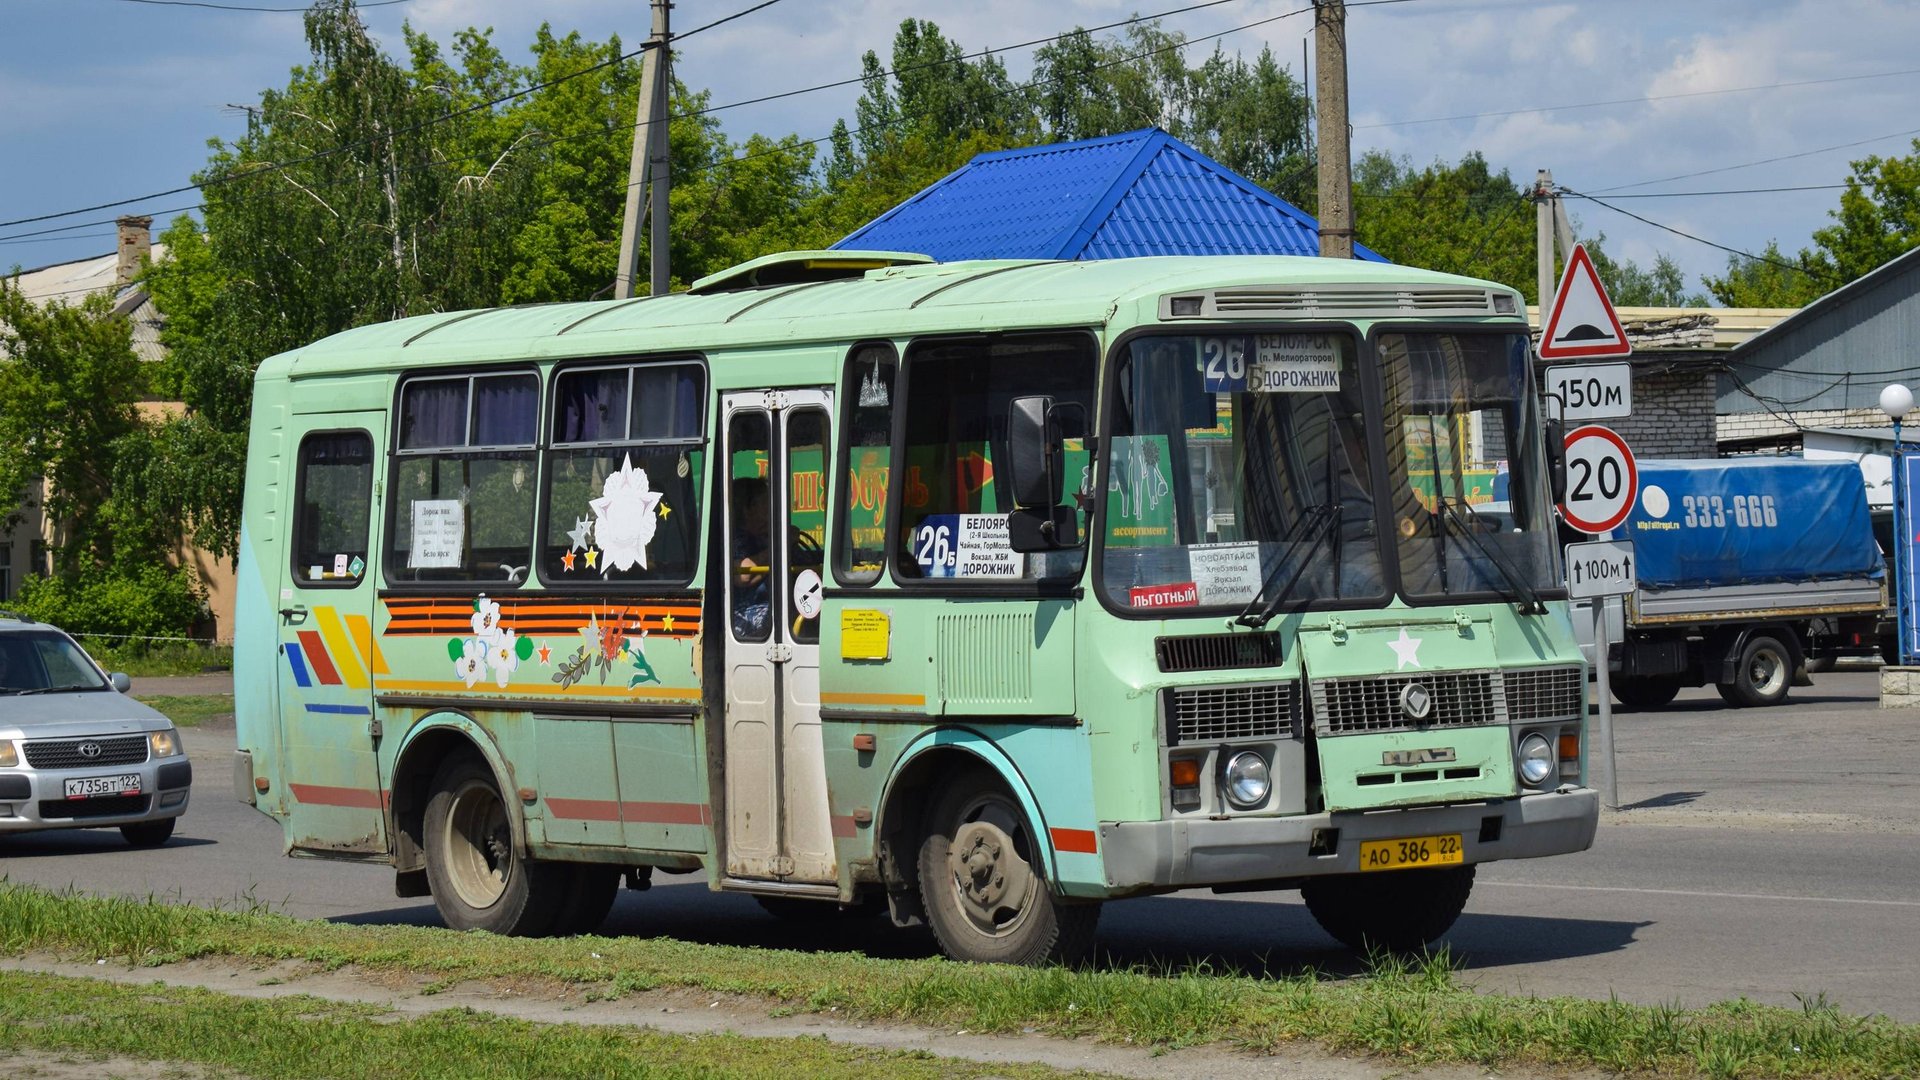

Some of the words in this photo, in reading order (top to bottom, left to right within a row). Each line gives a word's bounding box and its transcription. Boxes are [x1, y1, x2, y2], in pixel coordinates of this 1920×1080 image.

[1205, 338, 1245, 379] 26
[1273, 352, 1336, 363] Мелиораторов)
[1264, 371, 1338, 388] ДОРОЖНИК
[1569, 456, 1622, 502] 20
[1682, 495, 1778, 528] 333-666
[994, 553, 1009, 561] ЖБИ
[962, 563, 1015, 576] ДОРОЖНИК
[1132, 587, 1197, 608] ЛЬГОТНЫЙ
[1205, 585, 1252, 596] ДОРОЖНИК
[120, 776, 137, 786] 122
[1398, 841, 1430, 863] 386
[1440, 837, 1456, 854] 22
